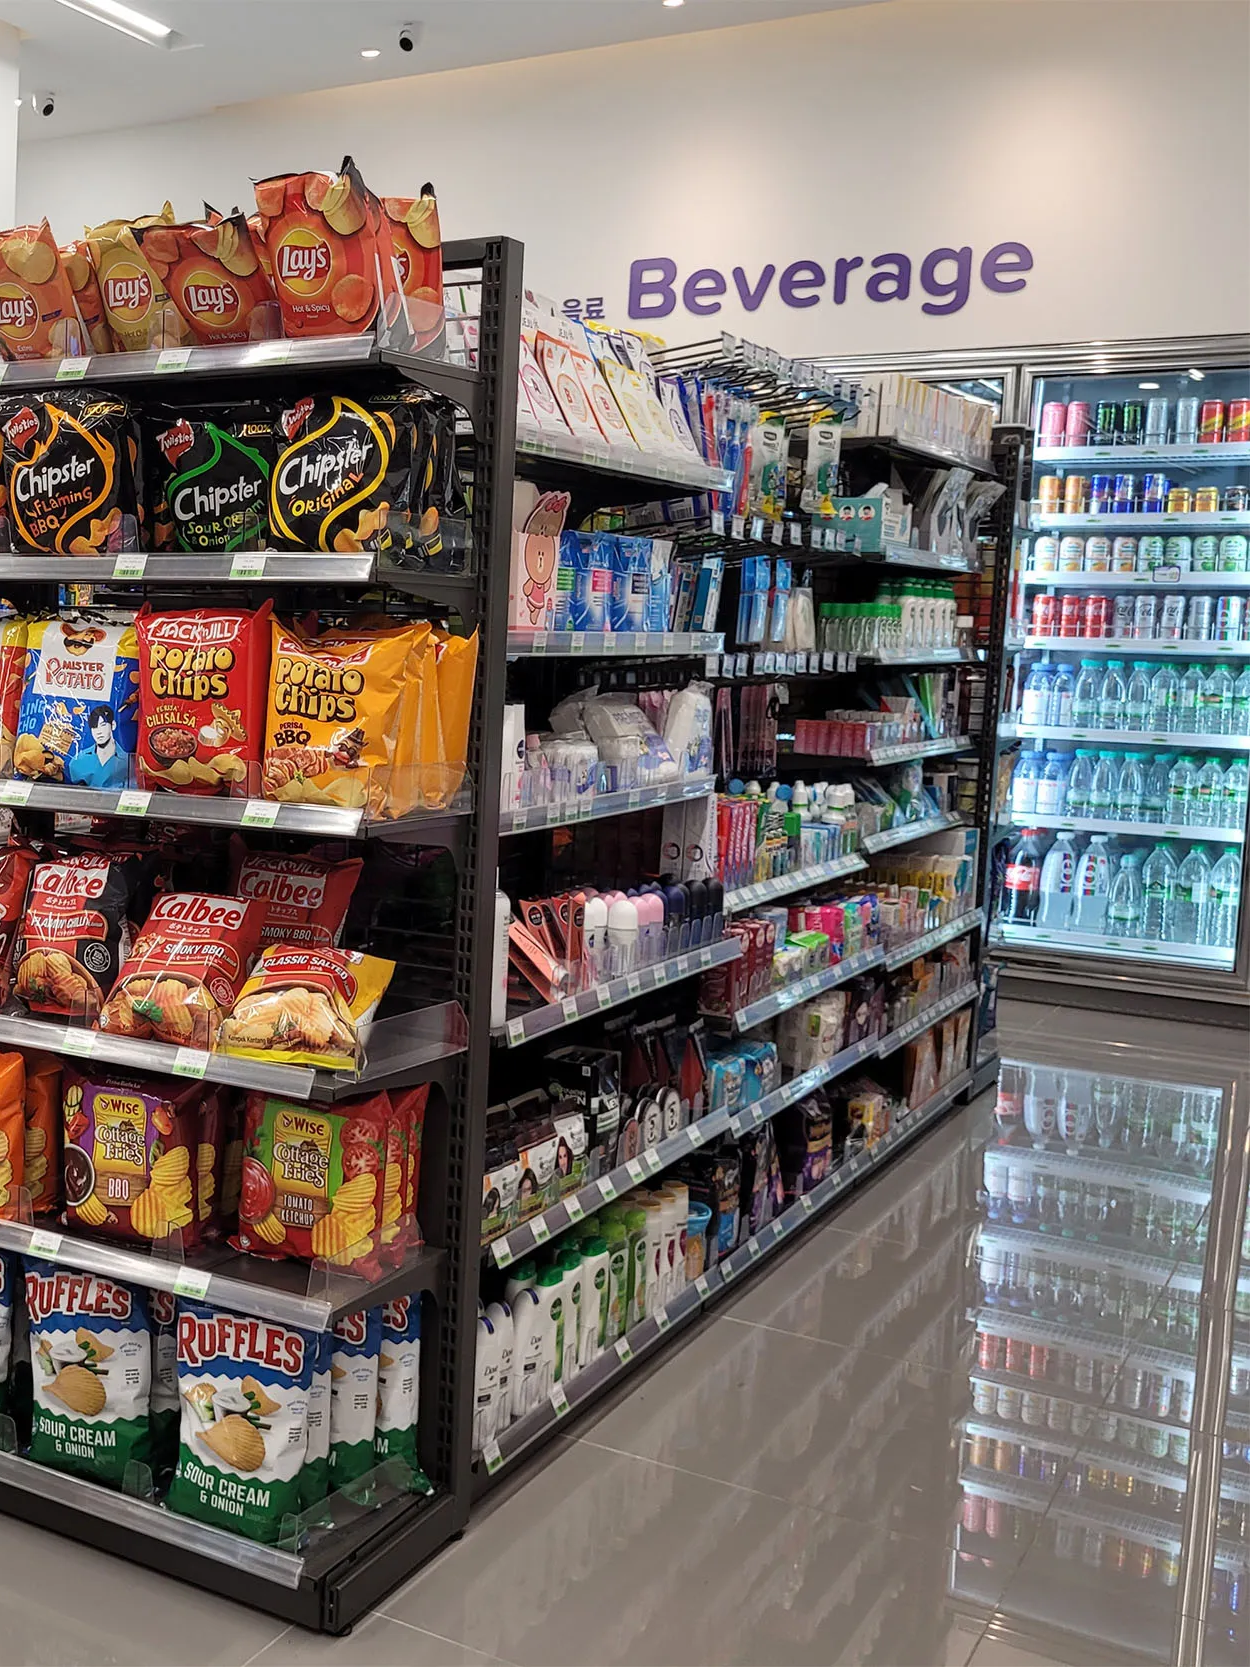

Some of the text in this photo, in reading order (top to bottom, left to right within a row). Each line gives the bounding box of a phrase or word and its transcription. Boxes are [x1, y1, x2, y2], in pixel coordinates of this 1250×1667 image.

[280, 245, 329, 281] Lay's
[108, 276, 151, 309] Lay's
[628, 241, 1034, 320] Beverage
[188, 285, 238, 315] Lay's
[292, 305, 305, 313] Hot
[311, 304, 331, 314] Spicy
[561, 296, 606, 320] 음료
[2, 416, 40, 438] Twisties
[156, 429, 195, 450] Twisties
[16, 455, 96, 503] Chipster
[279, 441, 374, 496] Chipster
[174, 477, 263, 521] Chipster
[29, 515, 61, 538] BBQ
[62, 661, 105, 672] MISTER
[149, 645, 234, 672] Potato
[45, 658, 105, 691] POTATO
[150, 669, 229, 701] Chips
[275, 658, 365, 695] Potato
[275, 684, 357, 722] Chips
[274, 729, 311, 747] BBQ
[279, 722, 304, 731] PERISA
[239, 871, 322, 907] Calbee
[155, 896, 242, 929] Calbee
[293, 928, 312, 941] BBQ
[201, 944, 225, 957] BBQ
[264, 955, 349, 981] CLASSIC SALTED
[94, 1124, 146, 1151] Cottage
[103, 1143, 144, 1166] Fries
[273, 1142, 329, 1171] Cottage
[282, 1162, 325, 1188] Fries
[108, 1178, 129, 1200] BBQ
[282, 1194, 313, 1212] TOMATO
[281, 1210, 315, 1226] KETCHUP
[25, 1272, 132, 1323] RUFFLES
[176, 1312, 305, 1375] RUFFLES
[39, 1416, 117, 1448] SOUR CREAM
[55, 1439, 95, 1459] & ONION
[183, 1462, 271, 1508] SOUR CREAM
[199, 1490, 245, 1517] & ONION
